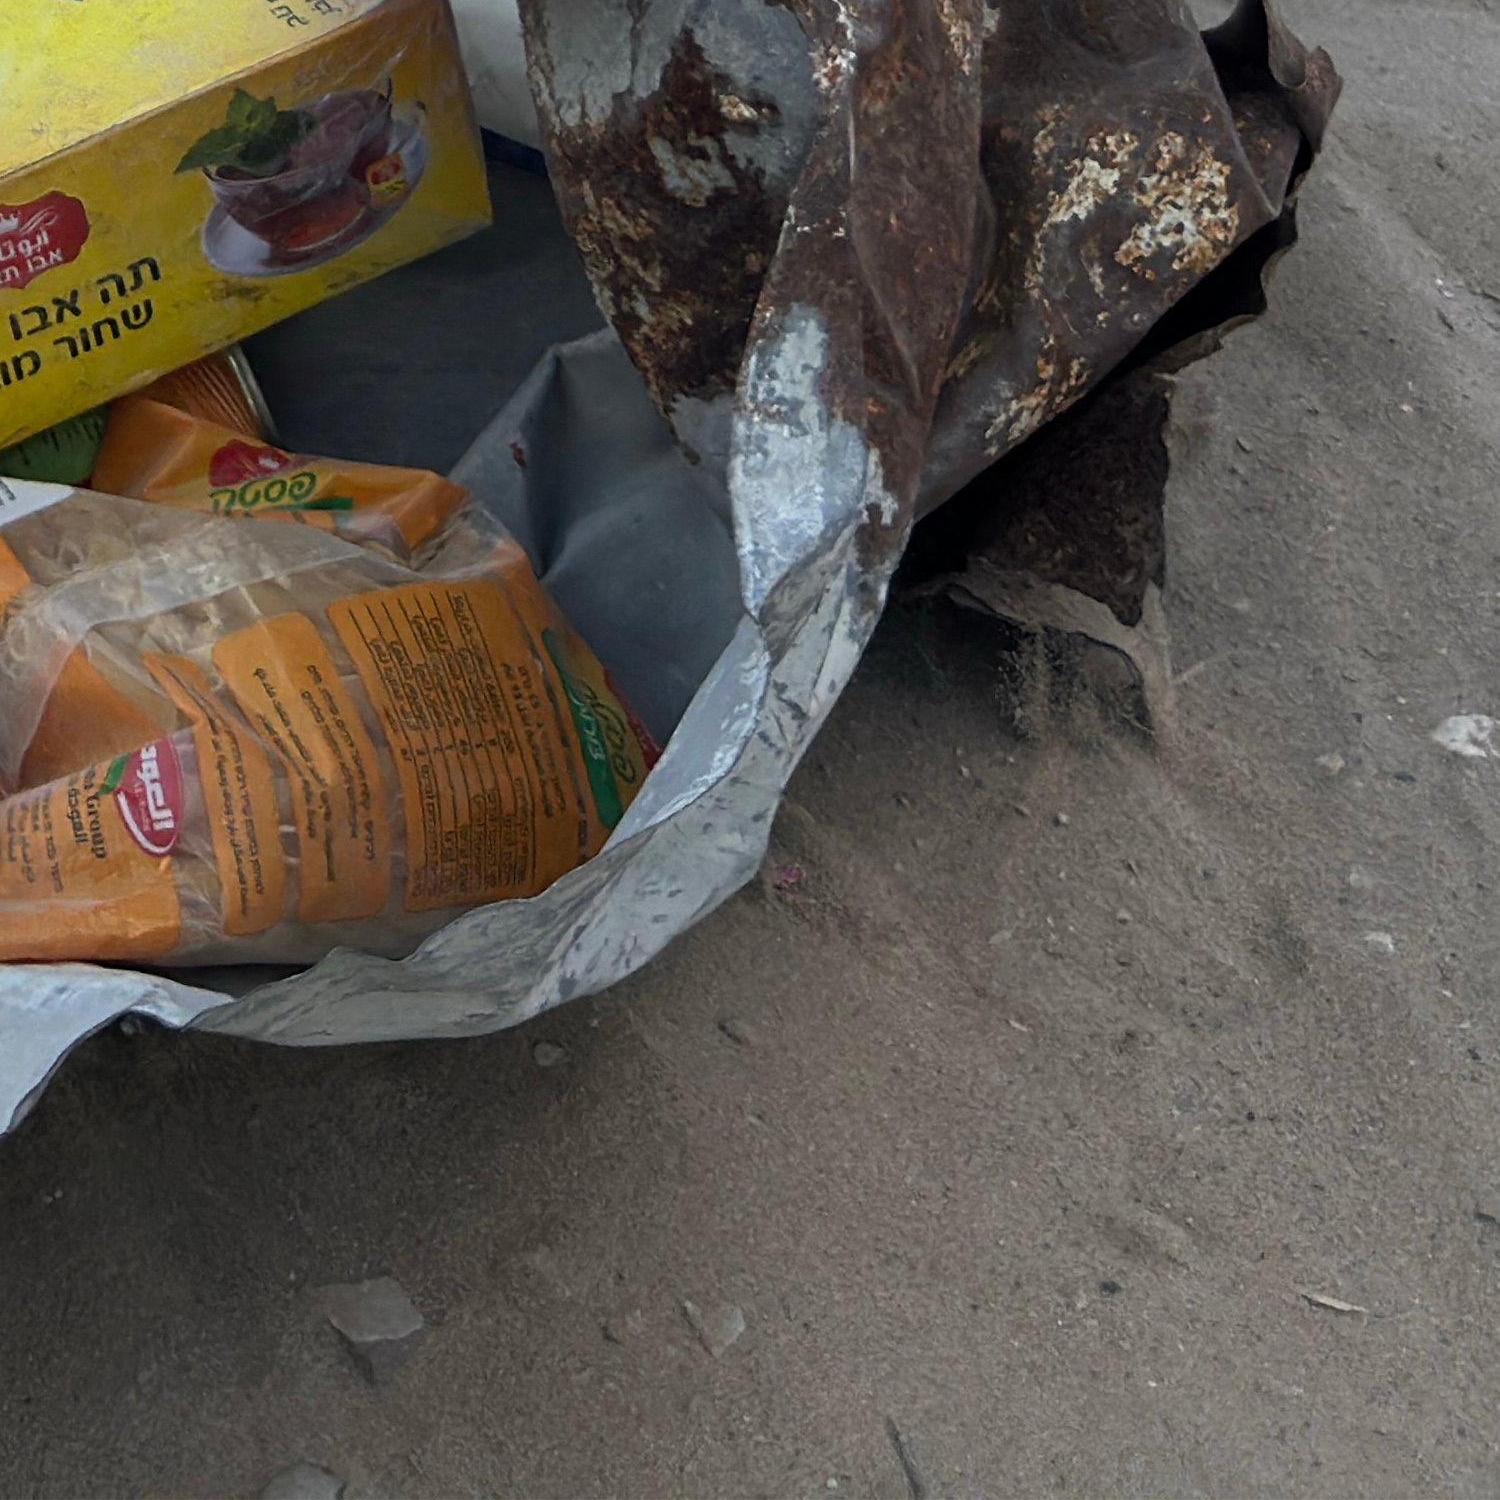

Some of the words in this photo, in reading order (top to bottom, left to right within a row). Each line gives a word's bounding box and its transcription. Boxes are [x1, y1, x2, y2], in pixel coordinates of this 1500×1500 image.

[24, 247, 64, 271] אבו
[95, 254, 161, 305] תה
[8, 288, 83, 340] אבו
[52, 298, 154, 359] שחור
[208, 471, 317, 516] פסטה
